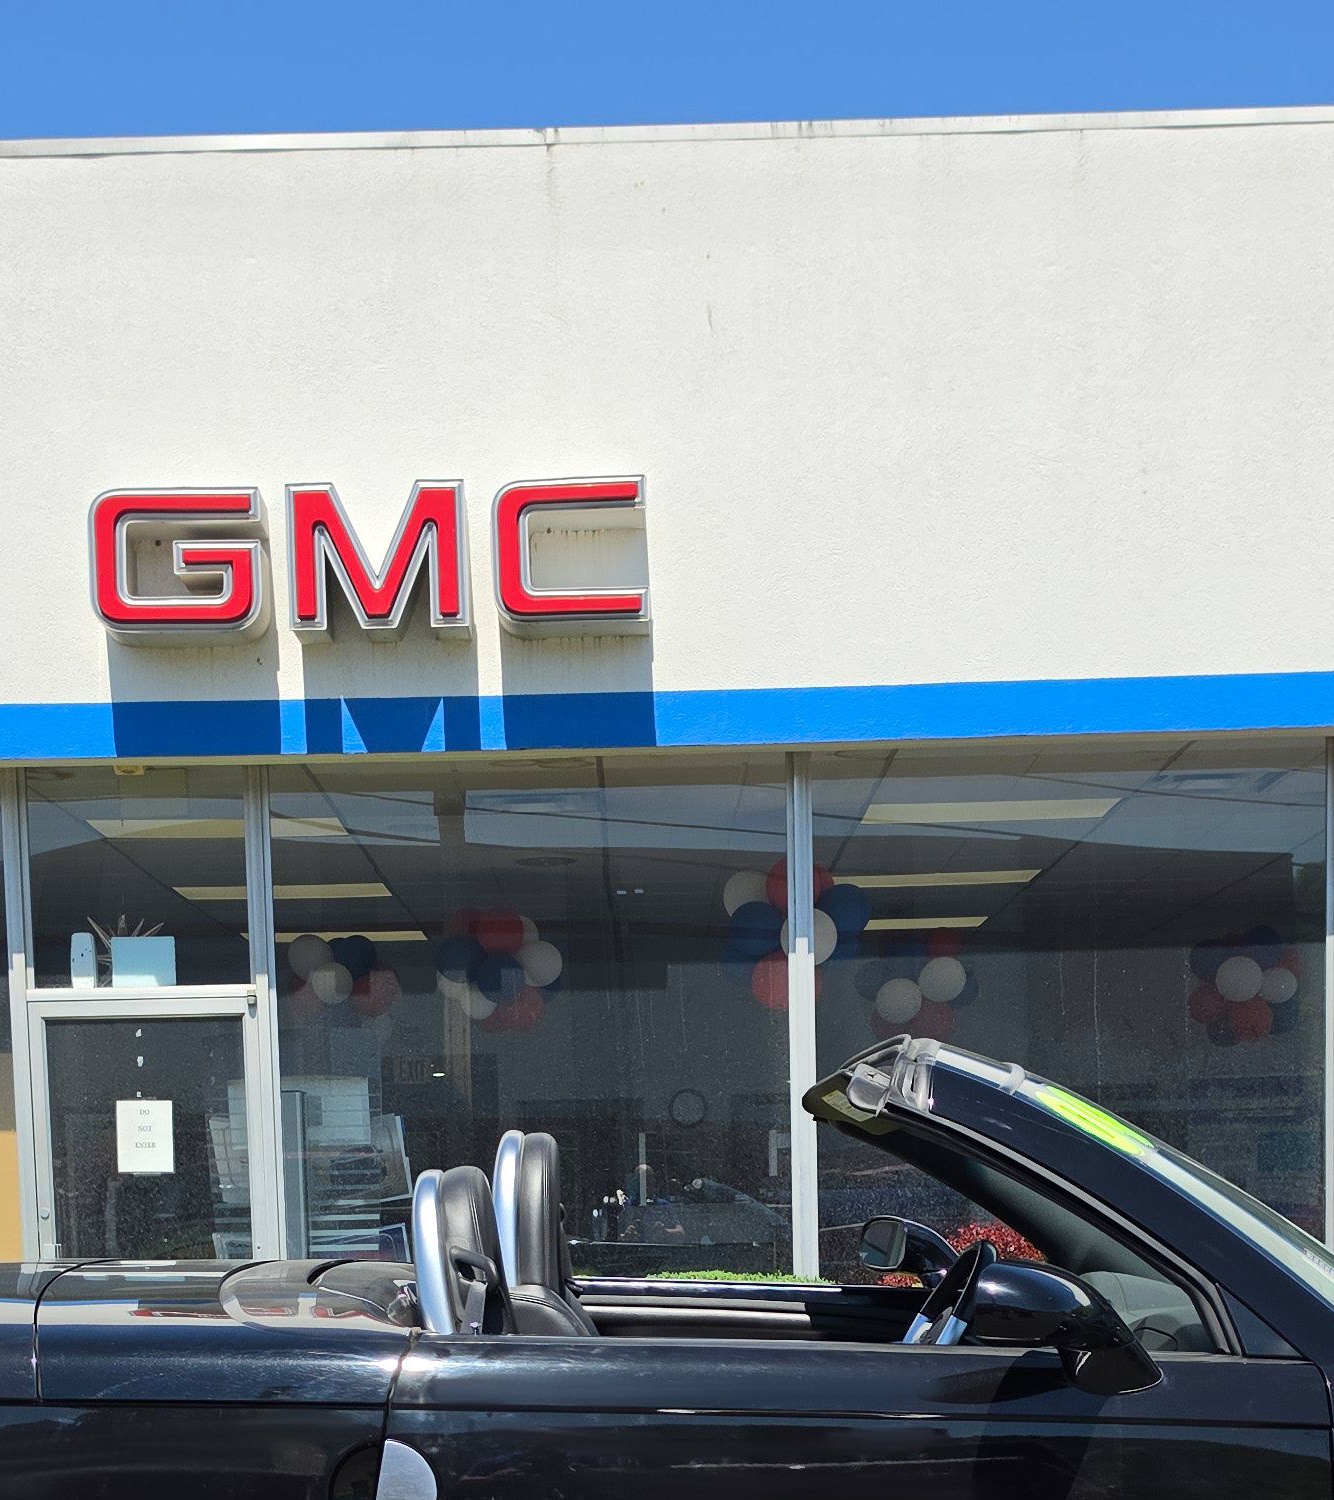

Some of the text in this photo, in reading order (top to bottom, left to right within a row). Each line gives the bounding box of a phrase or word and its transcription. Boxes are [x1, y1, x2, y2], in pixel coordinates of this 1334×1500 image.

[88, 475, 650, 633] GMC
[138, 1108, 151, 1116] DO
[134, 1141, 157, 1149] ENTER
